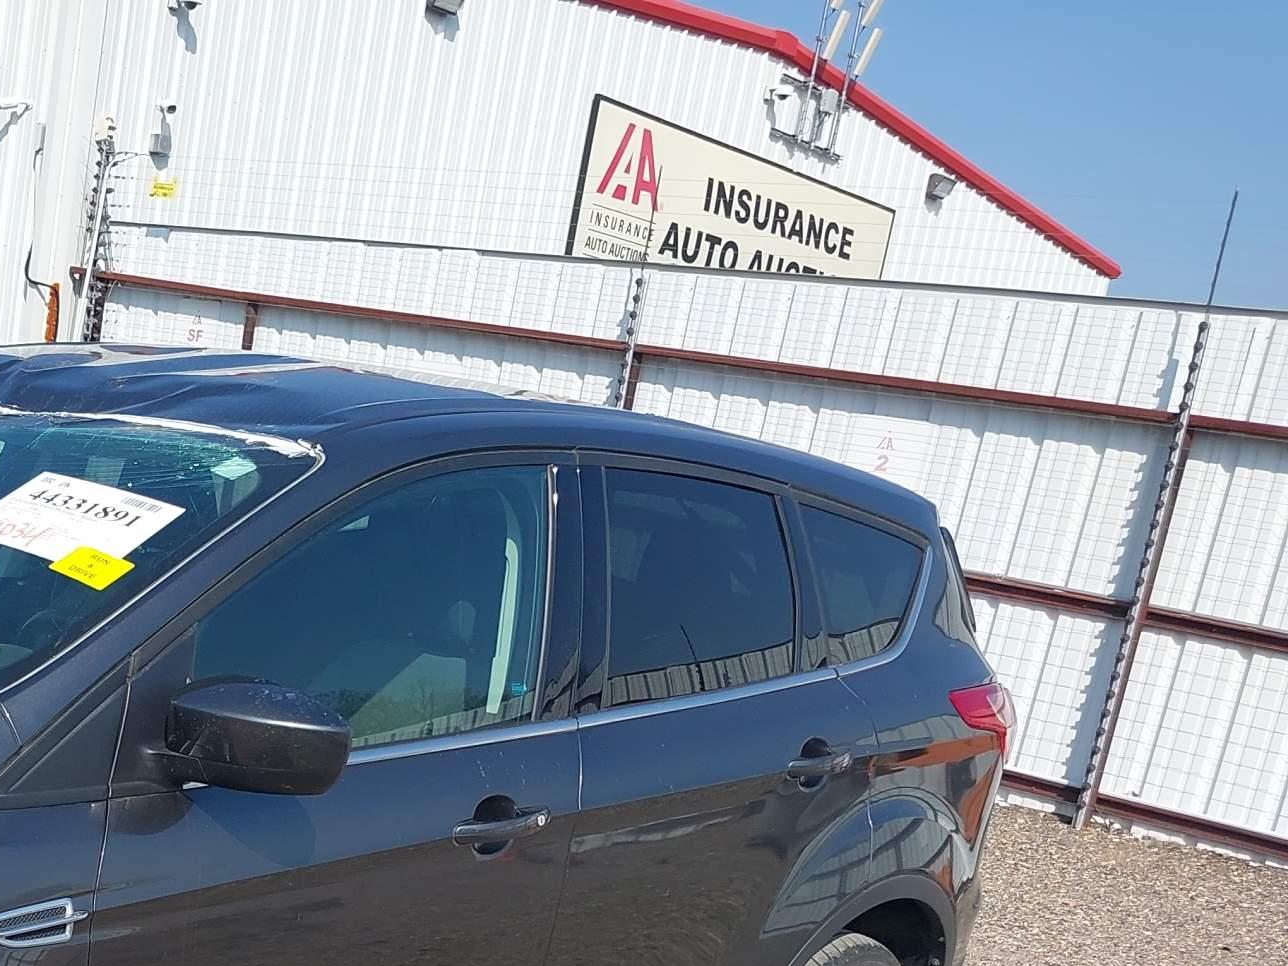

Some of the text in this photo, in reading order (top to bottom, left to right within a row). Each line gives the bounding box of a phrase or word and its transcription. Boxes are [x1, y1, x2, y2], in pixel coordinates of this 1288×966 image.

[589, 210, 655, 242] INSURANCE
[703, 177, 854, 261] INSURANCE
[584, 236, 608, 254] AUTO
[658, 222, 739, 269] AUTO
[187, 329, 203, 342] SF
[874, 455, 889, 472] 2
[28, 489, 142, 527] 44331891
[89, 554, 111, 566] RUN
[68, 564, 97, 580] DRIVE
